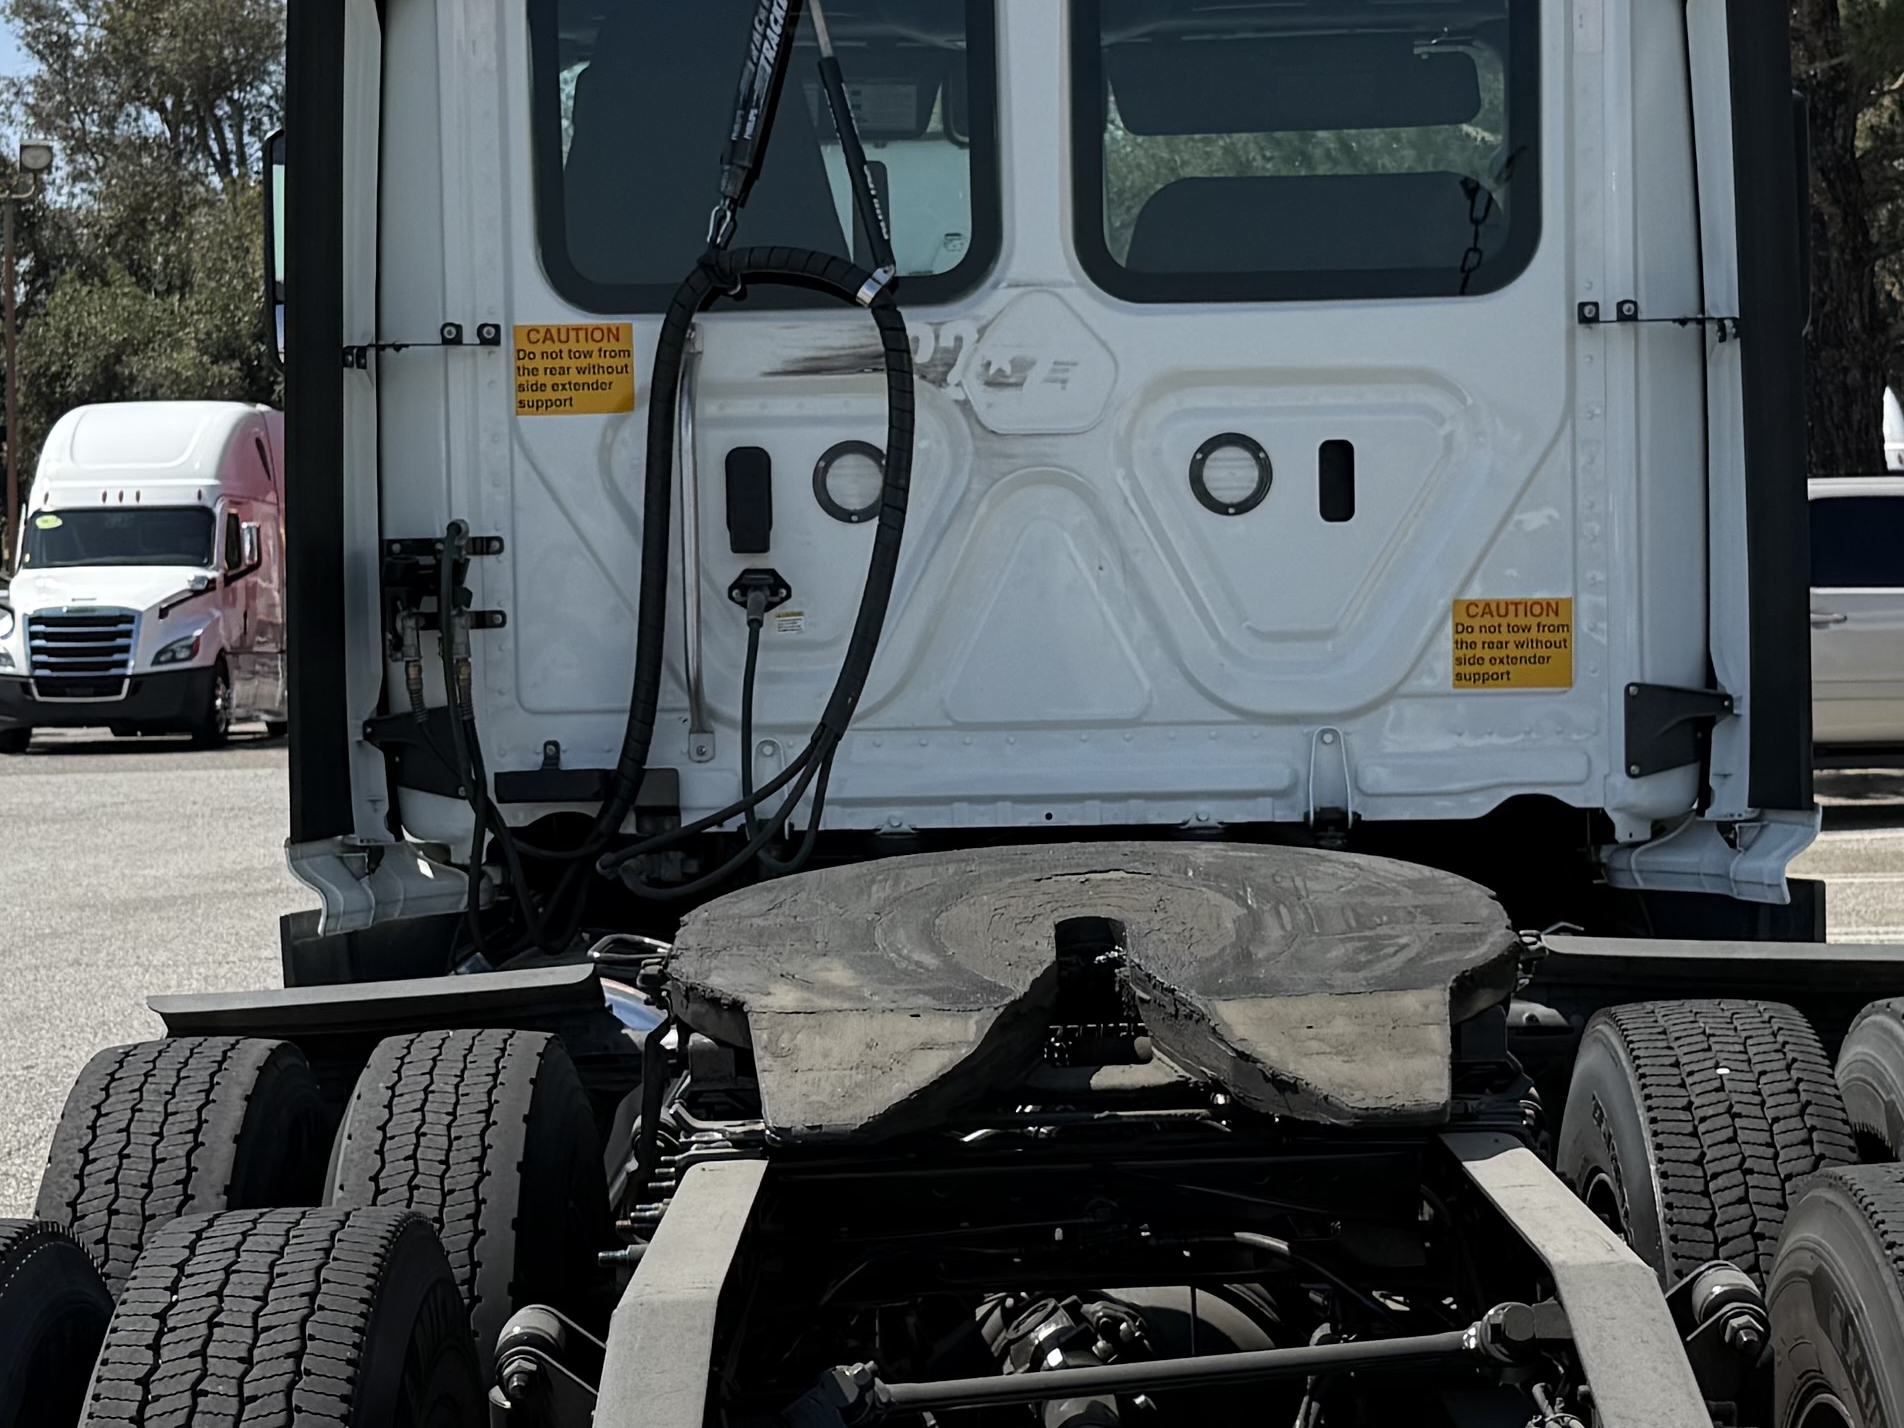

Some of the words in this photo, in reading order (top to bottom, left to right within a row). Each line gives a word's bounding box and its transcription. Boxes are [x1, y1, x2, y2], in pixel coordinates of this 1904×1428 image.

[527, 326, 620, 344] CAUTION
[516, 349, 536, 361] Do
[541, 349, 563, 360] not
[568, 349, 594, 360] tow
[598, 347, 631, 359] from
[517, 365, 539, 377] the
[544, 366, 572, 376] rear
[576, 363, 629, 375] without
[518, 380, 547, 392] side
[551, 379, 614, 392] extender
[518, 396, 573, 412] support
[1465, 600, 1560, 618] CAUTION
[1456, 622, 1475, 634] Do
[1479, 623, 1502, 634] not
[1507, 623, 1532, 634] tow
[1536, 622, 1570, 633] from
[1455, 638, 1477, 650] the
[1482, 640, 1510, 650] rear
[1514, 638, 1568, 650] without
[1455, 654, 1485, 666] side
[1489, 653, 1552, 666] extender
[1455, 670, 1511, 684] support
